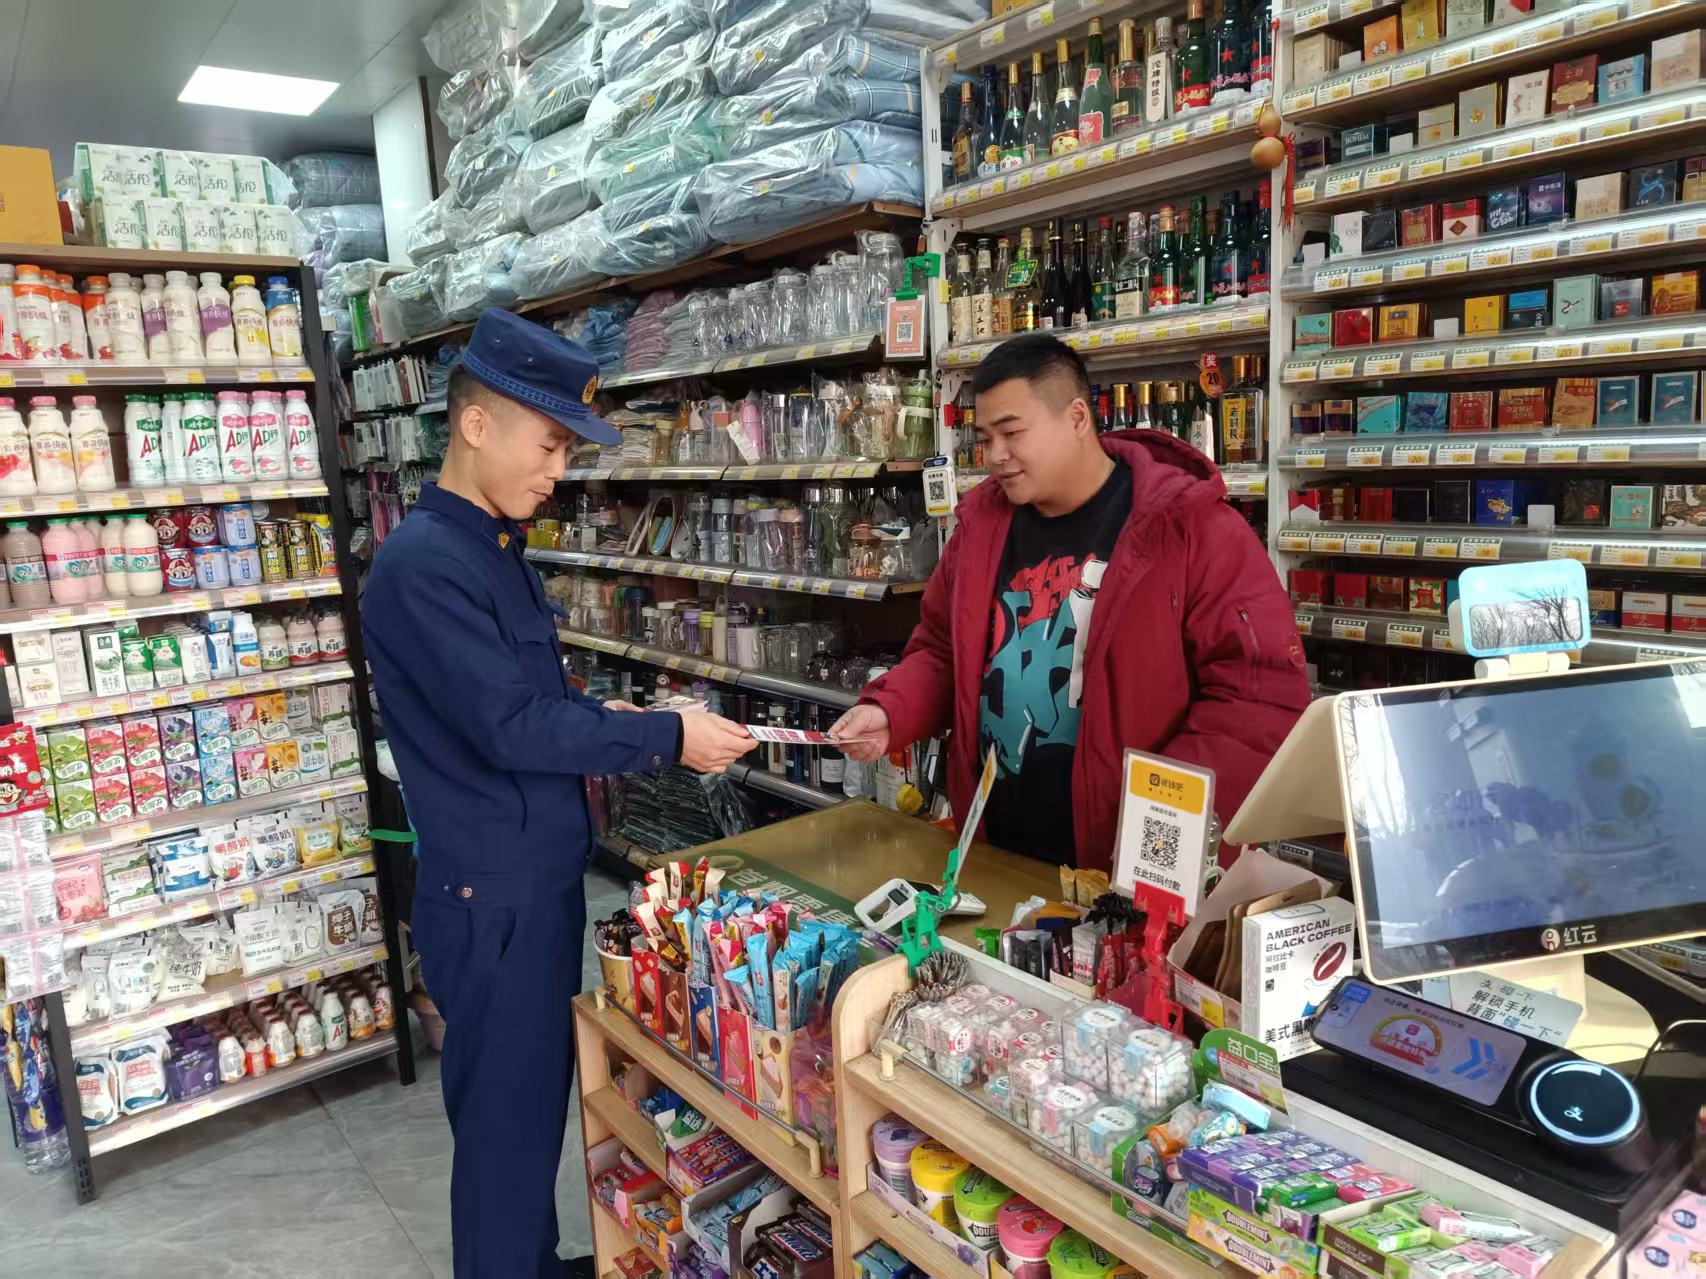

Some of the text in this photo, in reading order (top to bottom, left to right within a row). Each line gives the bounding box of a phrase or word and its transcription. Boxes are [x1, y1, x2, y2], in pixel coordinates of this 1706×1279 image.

[1345, 132, 1369, 145] BOHEM
[1206, 353, 1218, 367] 奖
[1207, 372, 1220, 385] 20
[1133, 865, 1181, 891] 在此扫码付款
[1266, 923, 1353, 953] BLACK COFFEE
[1267, 918, 1331, 941] AMERICAN
[1563, 924, 1597, 946] 红云
[1265, 950, 1296, 963] 阿拉比卡
[1265, 963, 1287, 974] 咖啡豆
[1471, 990, 1536, 1020] 解锁手机
[681, 1109, 702, 1131] 益达
[1226, 1212, 1269, 1242] DOUBLEMINT
[1228, 1241, 1273, 1270] DOUBLEMINT
